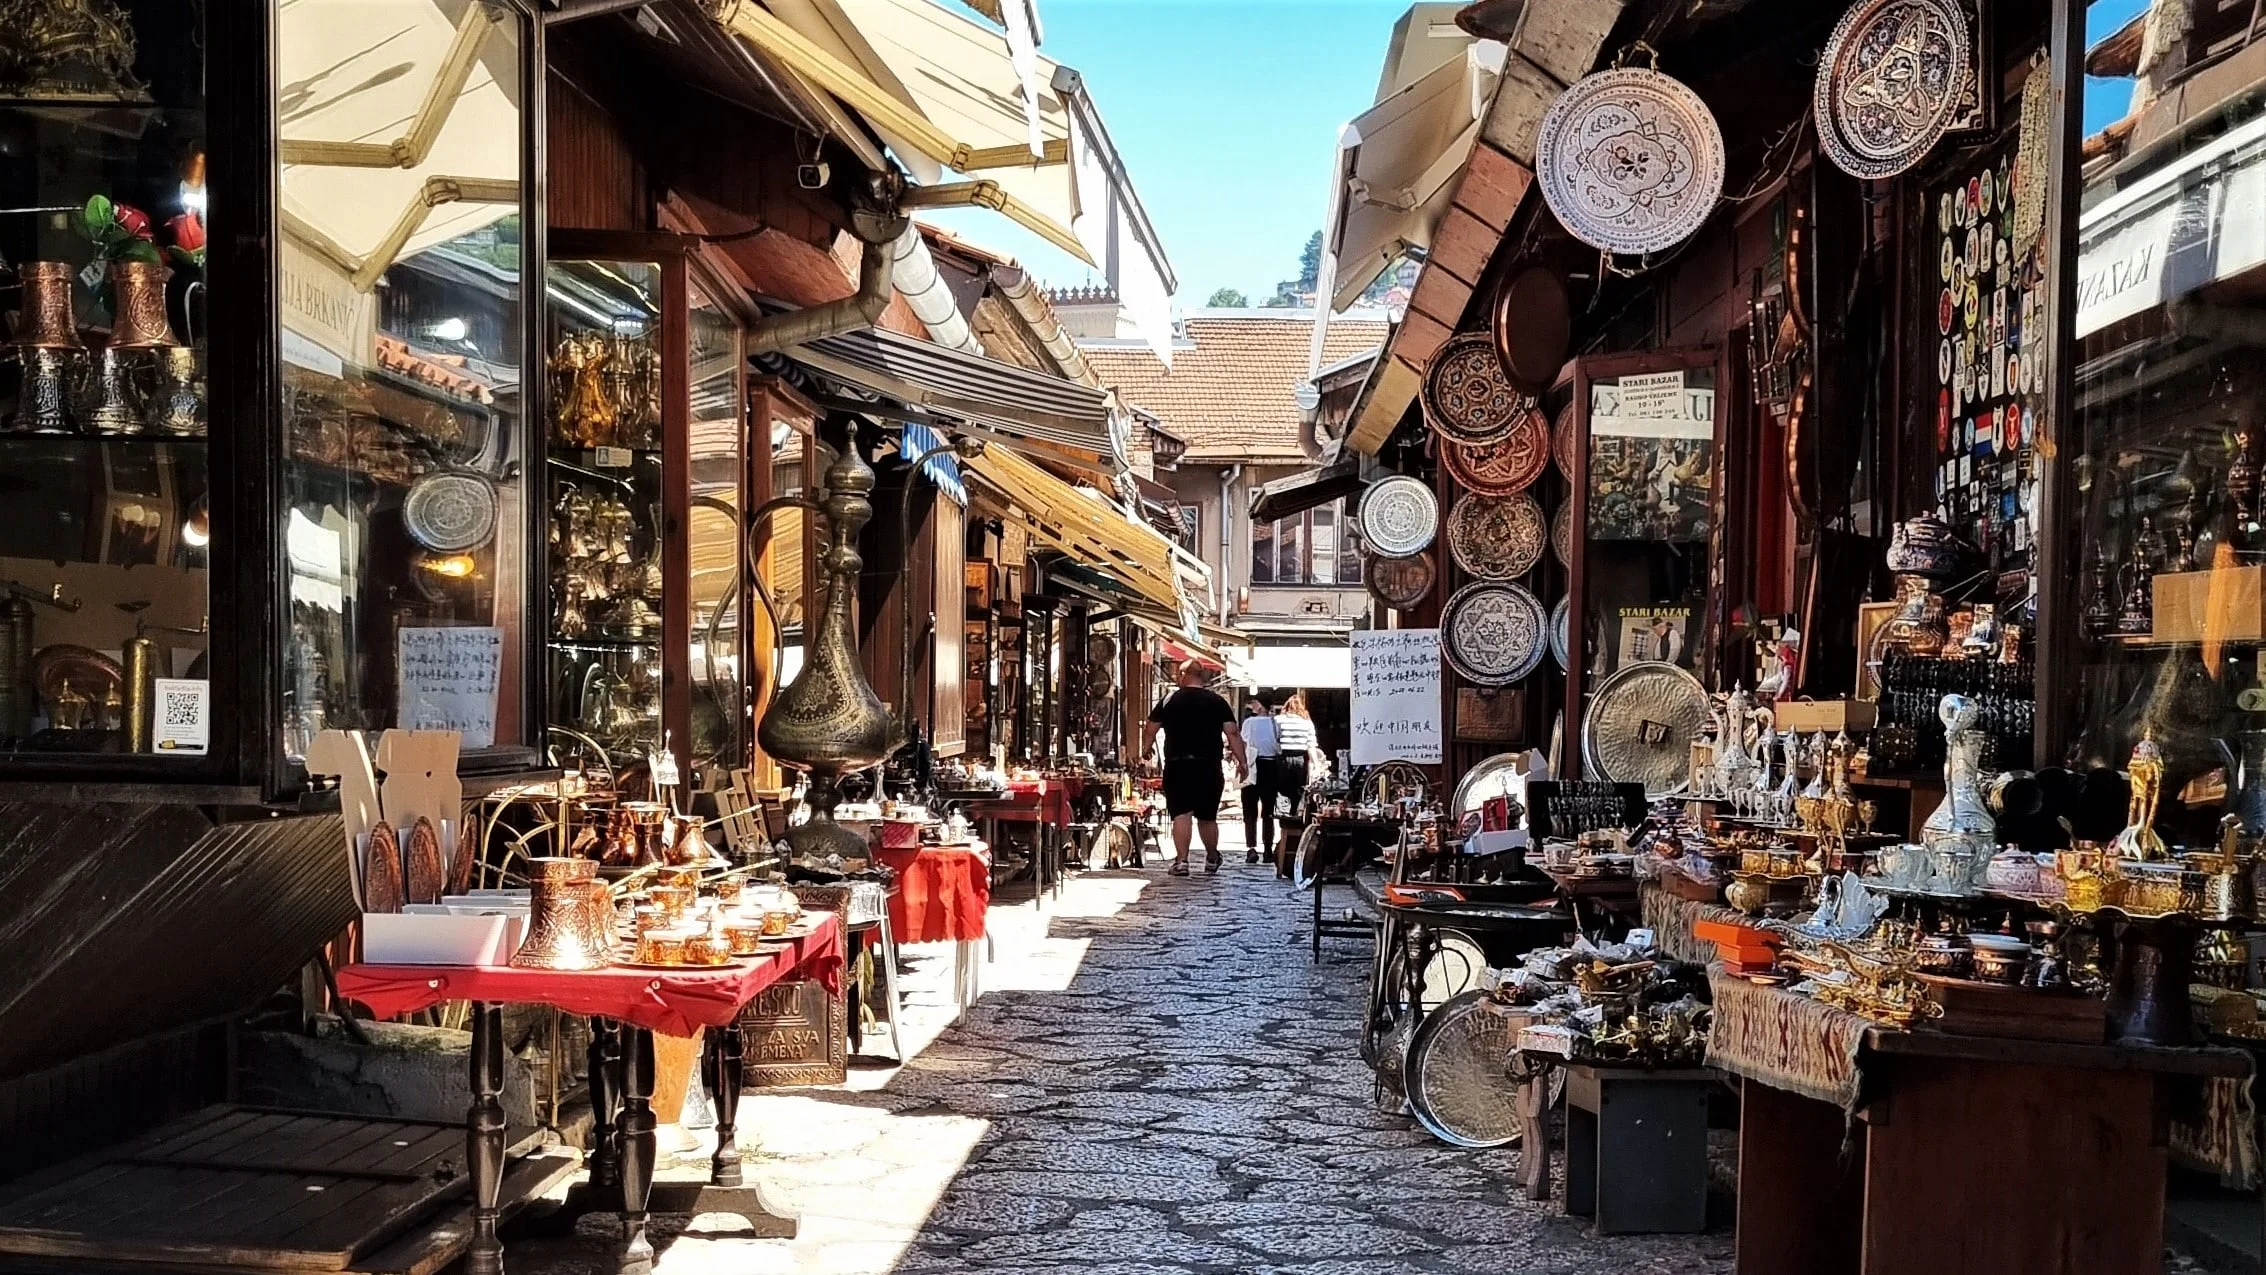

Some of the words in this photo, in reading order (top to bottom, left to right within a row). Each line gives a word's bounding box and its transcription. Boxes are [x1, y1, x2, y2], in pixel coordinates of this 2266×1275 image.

[1623, 379, 1649, 387] STARI
[1651, 376, 1679, 385] BAZAR
[1619, 608, 1650, 617] STARI
[1654, 608, 1690, 617] BAZAR
[1356, 717, 1438, 735] 欢迎中国朋友
[793, 1030, 820, 1045] SVA
